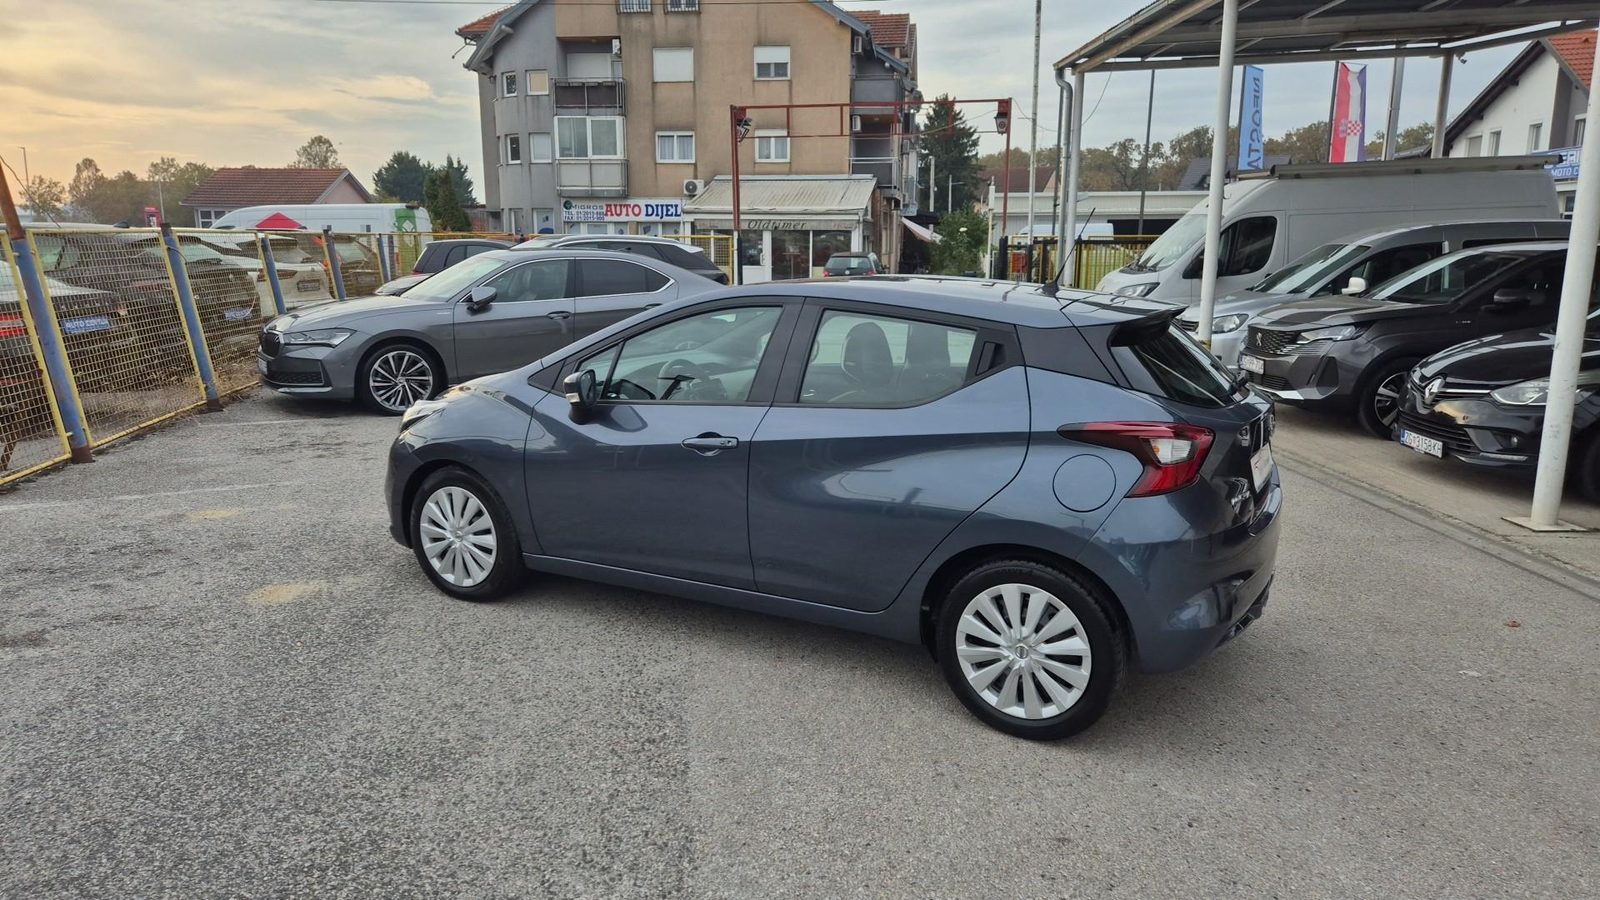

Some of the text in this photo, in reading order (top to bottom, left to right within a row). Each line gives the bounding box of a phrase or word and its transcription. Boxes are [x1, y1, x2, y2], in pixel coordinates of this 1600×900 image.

[604, 203, 682, 220] AUTO DIJEL
[747, 219, 807, 229] Oldtimer
